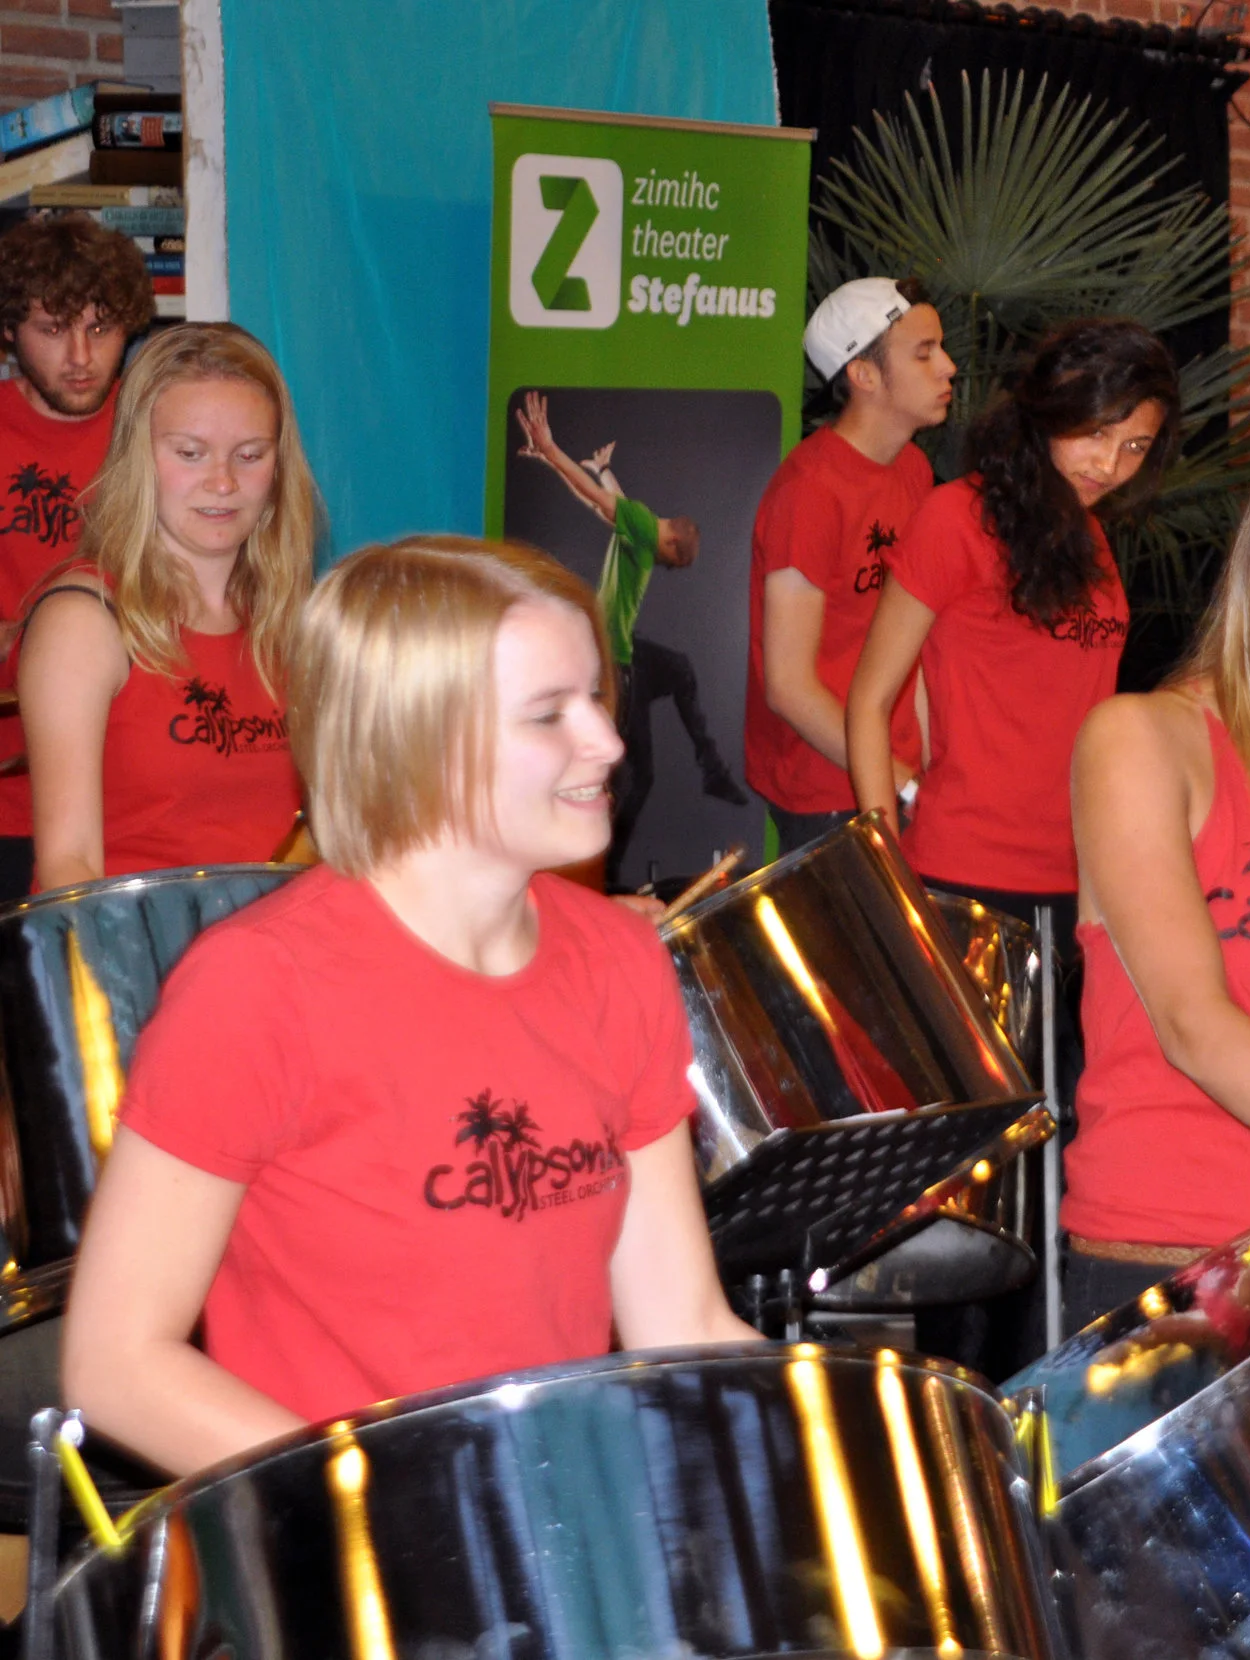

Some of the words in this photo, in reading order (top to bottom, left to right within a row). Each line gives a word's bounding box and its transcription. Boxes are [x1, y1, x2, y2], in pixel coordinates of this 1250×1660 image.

[630, 168, 720, 211] zimihc
[631, 218, 729, 261] theater
[627, 272, 777, 327] Stefanus
